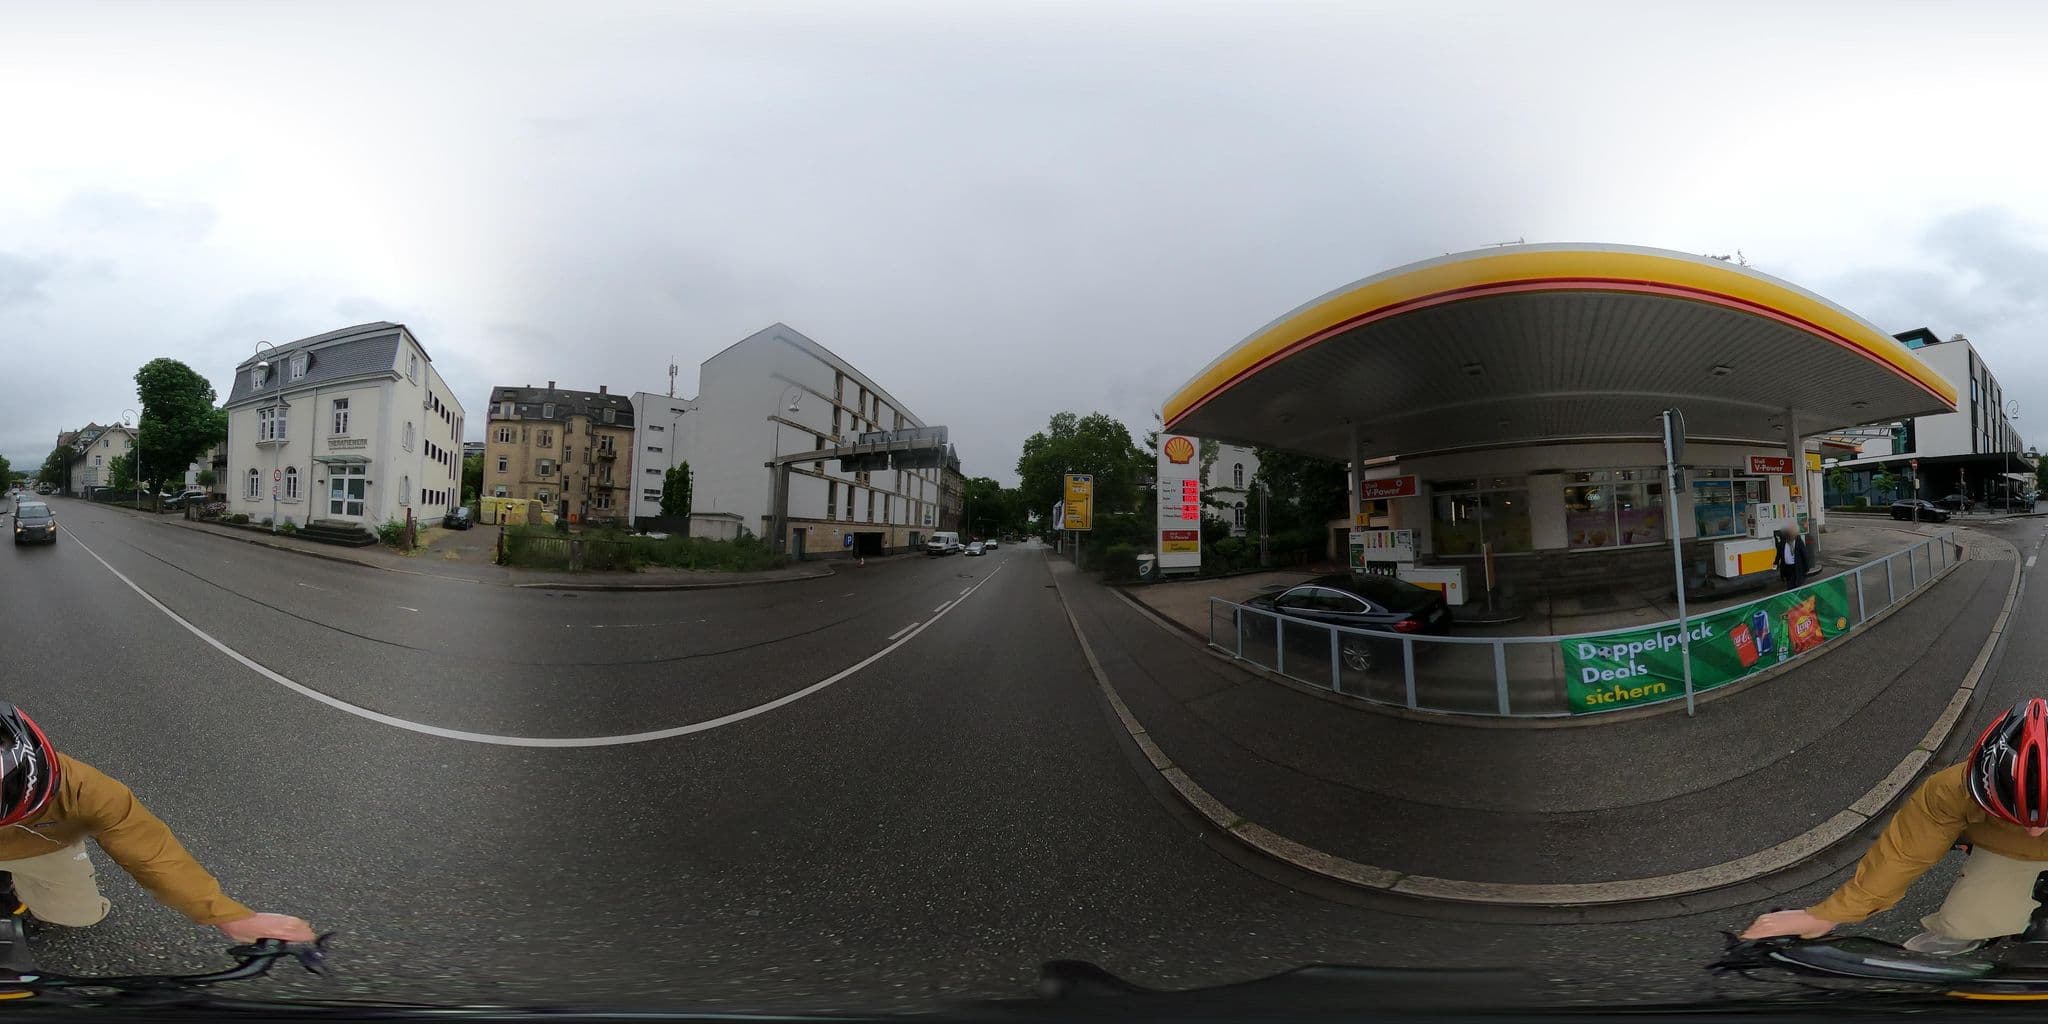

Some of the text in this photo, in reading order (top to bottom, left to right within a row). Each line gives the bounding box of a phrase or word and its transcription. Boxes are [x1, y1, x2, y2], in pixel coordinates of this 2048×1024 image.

[1754, 464, 1784, 472] V-Power
[1366, 488, 1401, 497] V-Power
[1582, 660, 1648, 683] Deals
[1586, 682, 1666, 705] sichern
